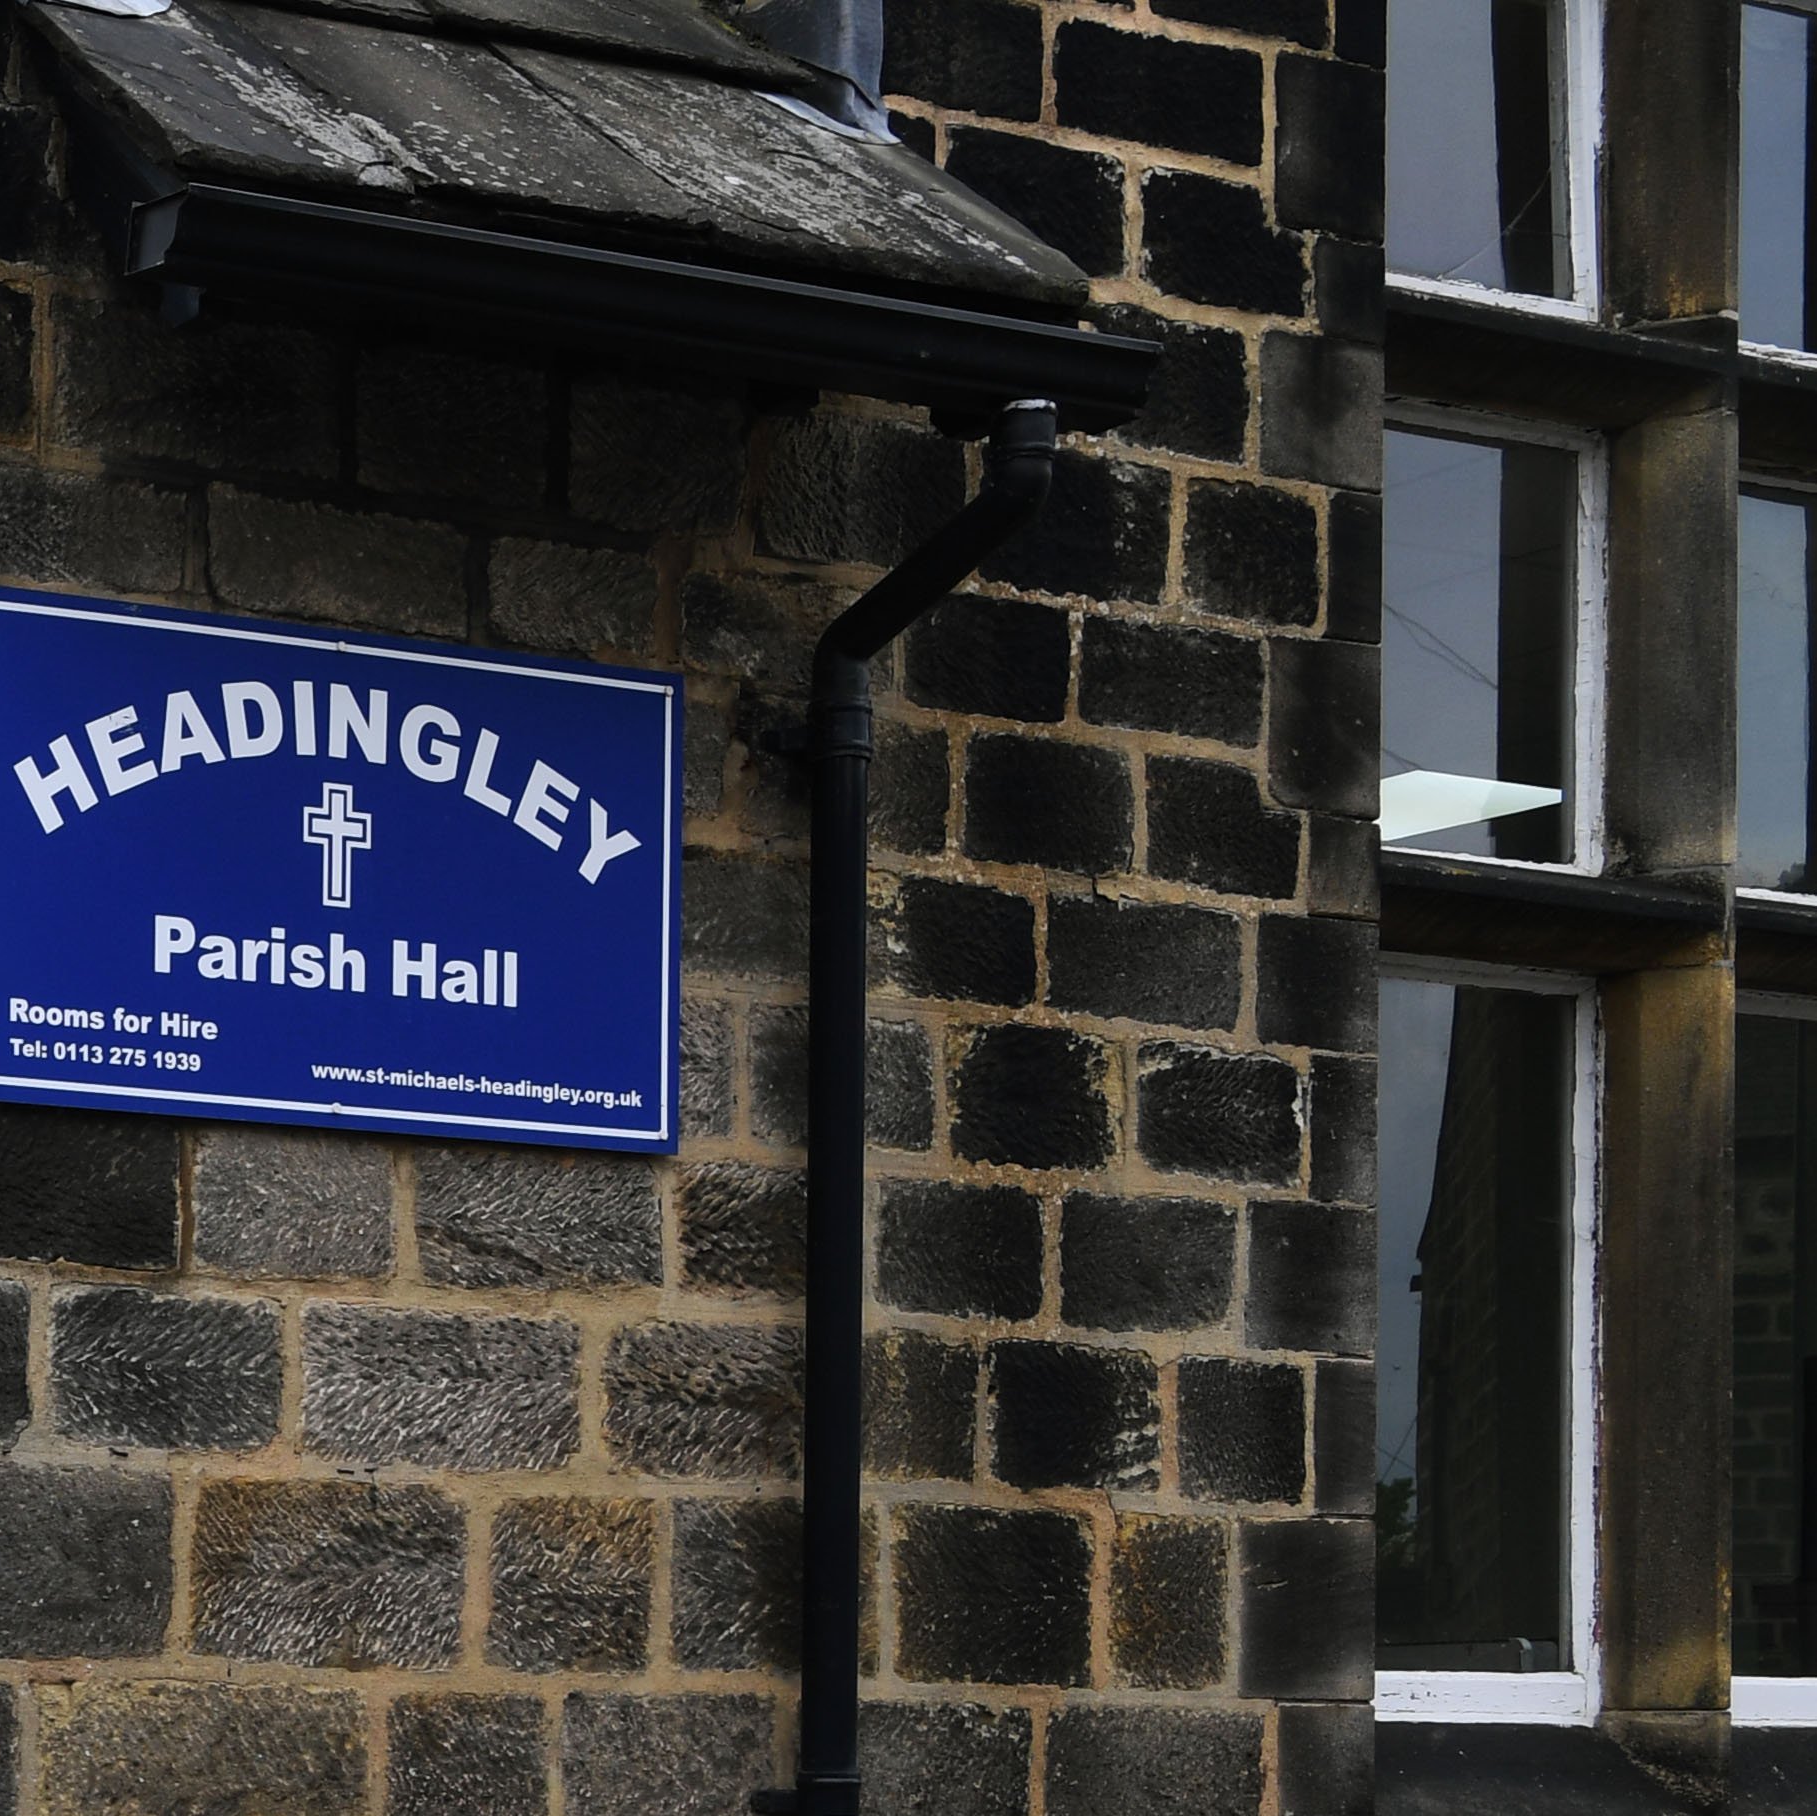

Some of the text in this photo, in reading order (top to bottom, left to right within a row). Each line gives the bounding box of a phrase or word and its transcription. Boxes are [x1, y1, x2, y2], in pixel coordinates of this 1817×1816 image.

[12, 680, 642, 885] HEADINGLEY
[154, 914, 518, 1008] Parish Hall
[9, 997, 218, 1040] Rooms for Hire
[9, 1038, 201, 1073] Tel: 0113 275 1939
[311, 1063, 642, 1109] www.st-michaels-headingley.org.uk
